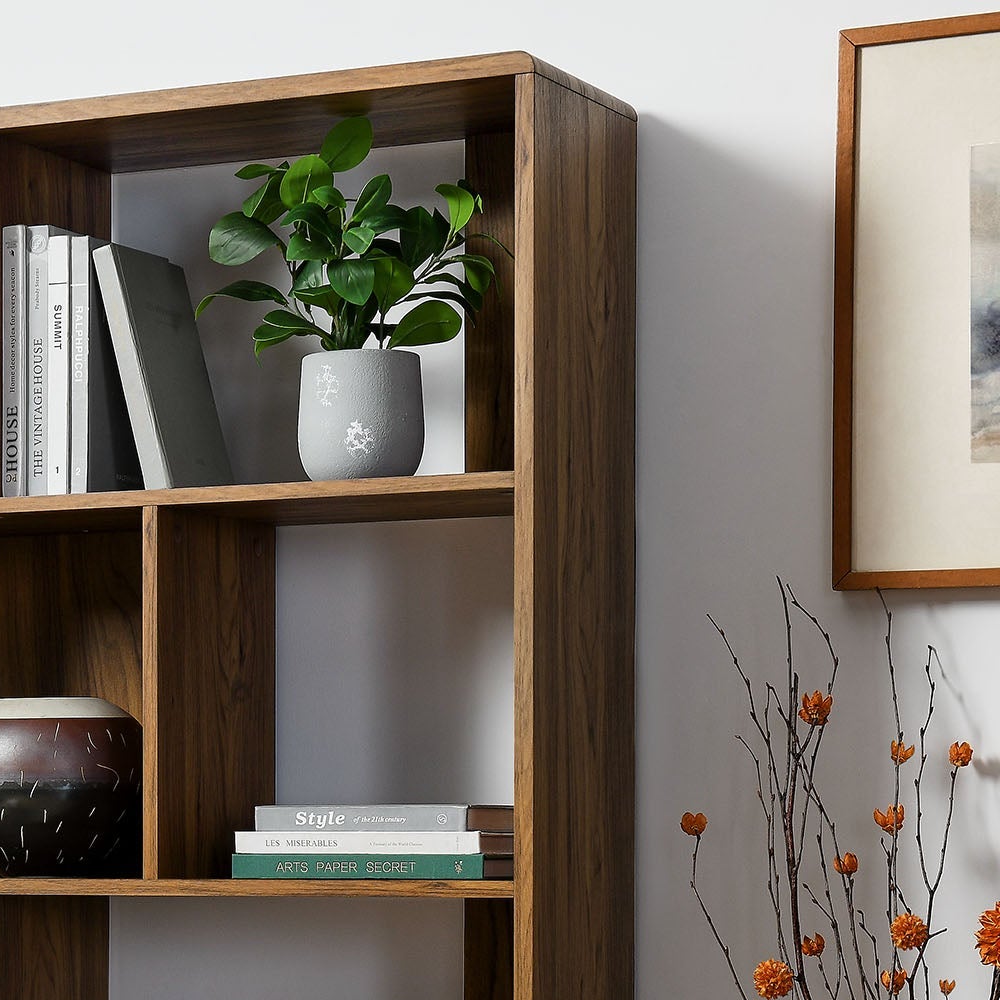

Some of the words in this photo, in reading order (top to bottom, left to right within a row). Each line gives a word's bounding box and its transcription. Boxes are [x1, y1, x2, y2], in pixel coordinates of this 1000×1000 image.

[53, 304, 63, 350] SUMMIT
[33, 338, 43, 386] HOUSE
[33, 388, 43, 446] VINTAGE
[6, 405, 19, 473] HOUSE
[33, 450, 43, 478] THE
[54, 465, 60, 474] 1
[75, 467, 81, 476] 2
[294, 811, 346, 829] Style
[265, 839, 281, 848] LES
[286, 839, 338, 848] MISERABLES
[275, 861, 309, 873] ARTS
[316, 861, 358, 873] PAPER
[366, 861, 416, 873] SECRET
